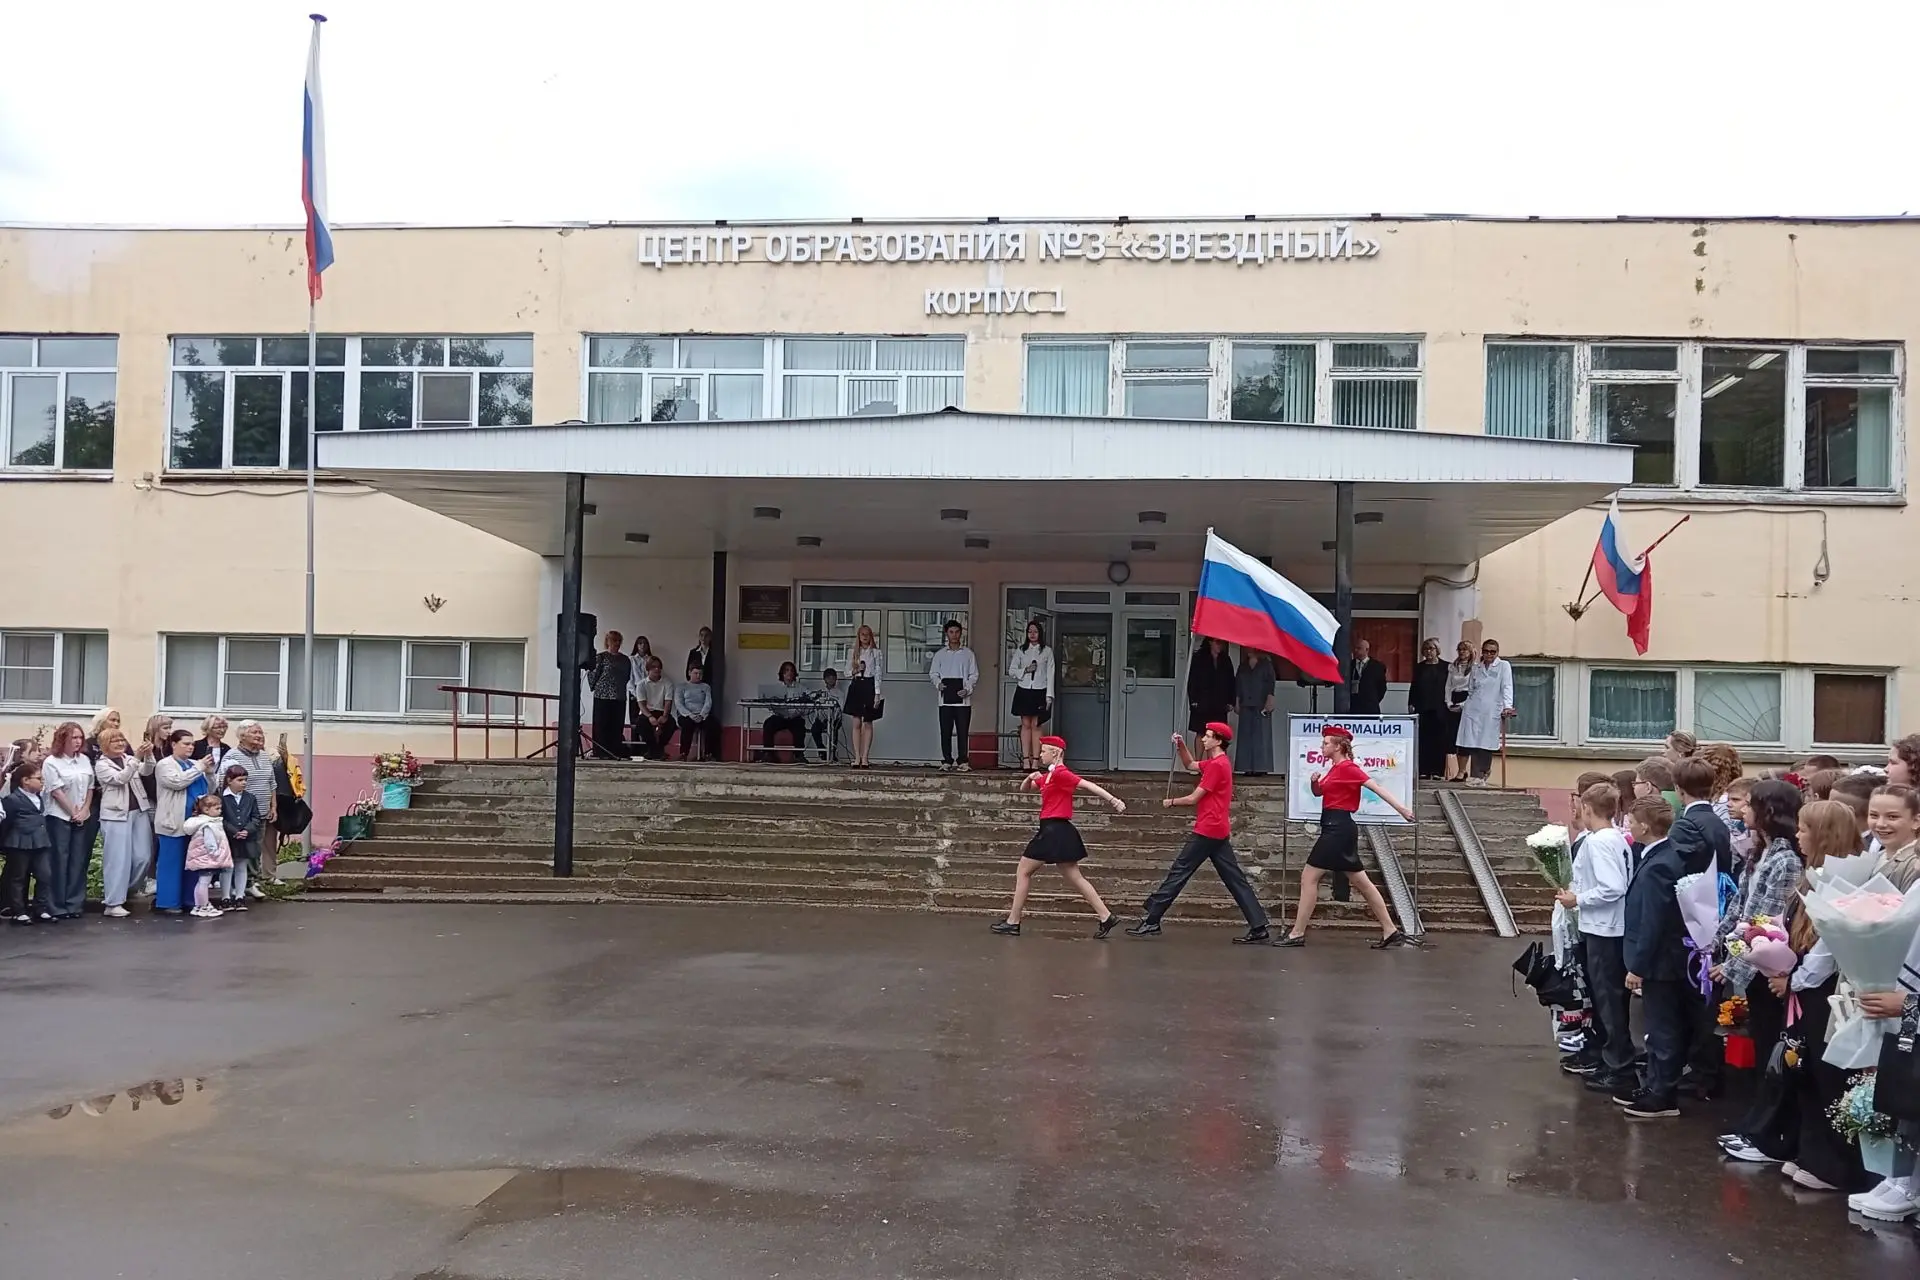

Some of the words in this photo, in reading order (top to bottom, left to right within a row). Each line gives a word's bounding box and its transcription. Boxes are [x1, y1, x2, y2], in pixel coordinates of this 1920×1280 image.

[638, 230, 753, 270] ЦЕНТР
[764, 227, 1026, 264] ОБРАЗОВАНИЯ
[1038, 226, 1107, 262] №3
[1120, 220, 1381, 267] «ЗВЕЗДНЫЙ»
[924, 286, 1038, 316] КОРПУС
[1050, 285, 1067, 314] 1
